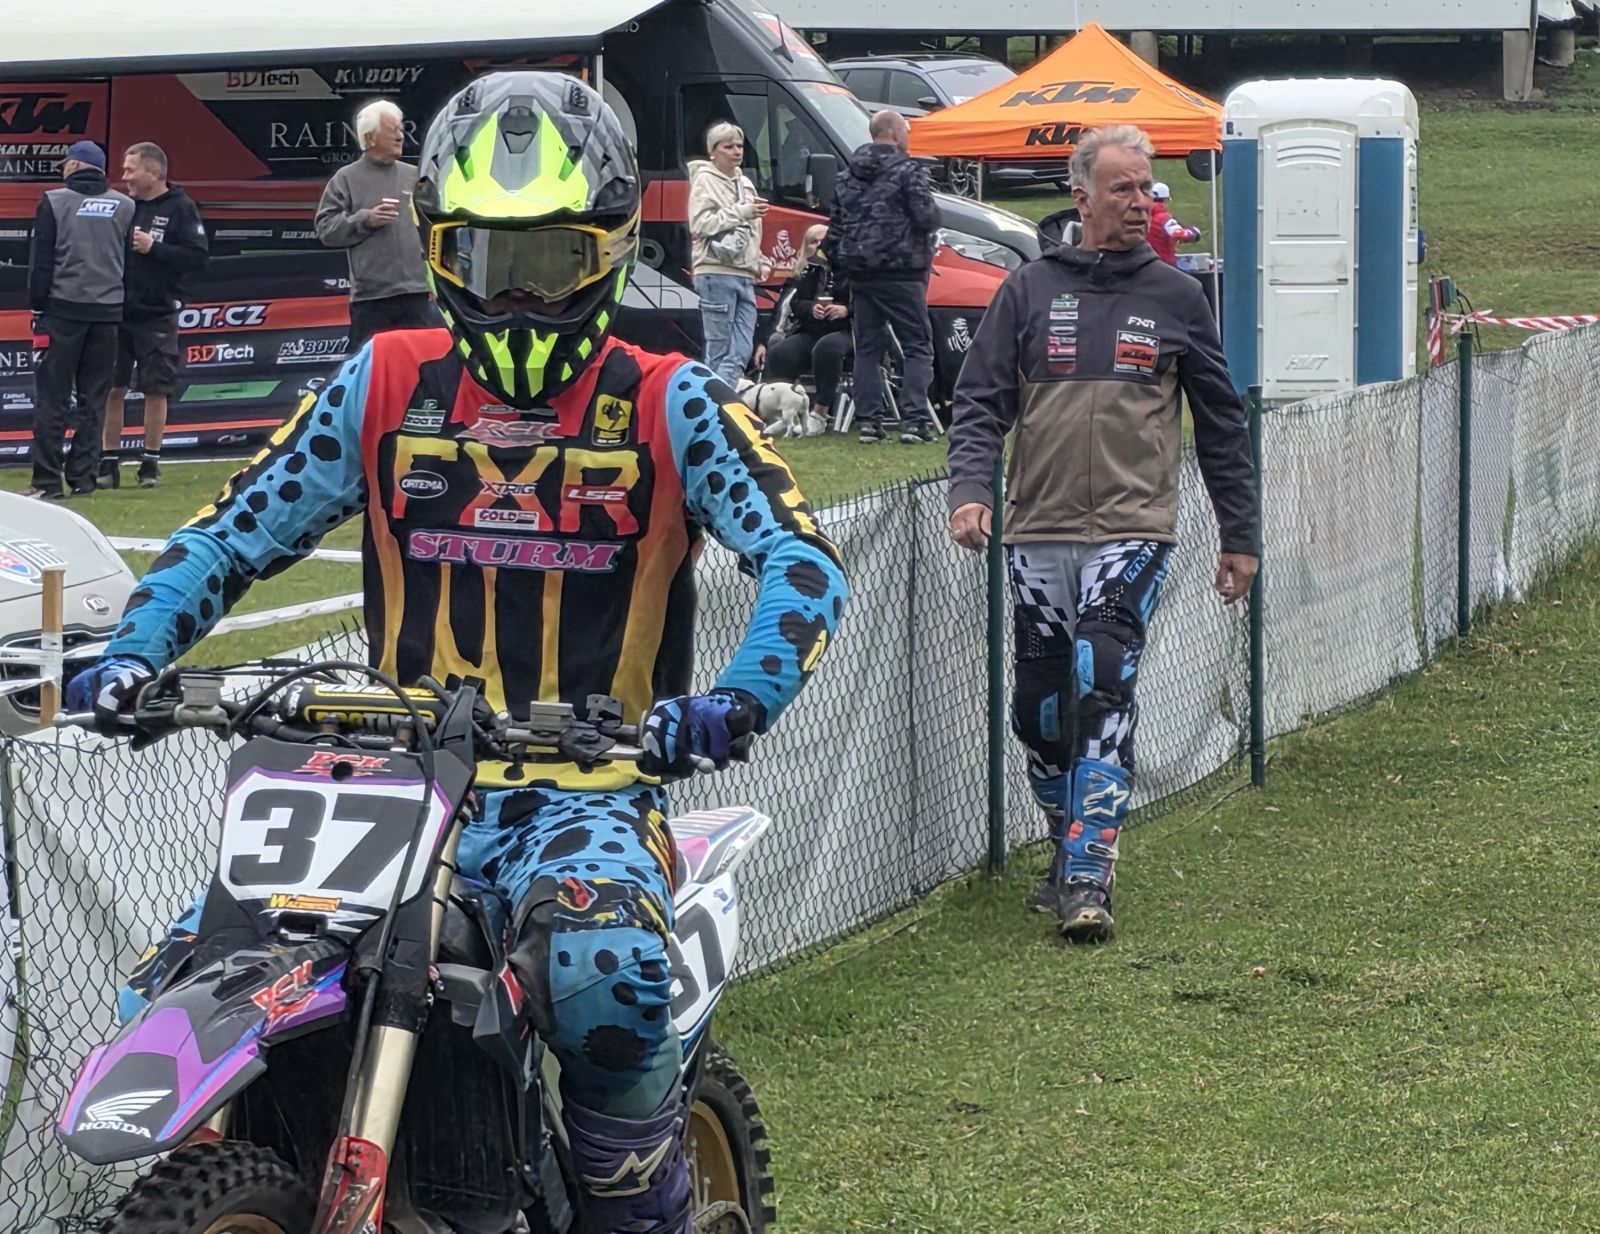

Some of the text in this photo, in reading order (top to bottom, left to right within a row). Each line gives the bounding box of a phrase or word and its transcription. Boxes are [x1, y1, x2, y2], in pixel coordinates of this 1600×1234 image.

[1000, 80, 1142, 108] KTM
[270, 120, 420, 148] RAINR
[0, 160, 64, 173] AINER
[1127, 316, 1156, 330] FXR
[187, 343, 255, 363] BDTech
[392, 435, 640, 535] FXR
[567, 488, 626, 501] LS2
[409, 531, 619, 571] STURM
[228, 788, 428, 894] 37
[76, 1120, 152, 1139] HONDA
